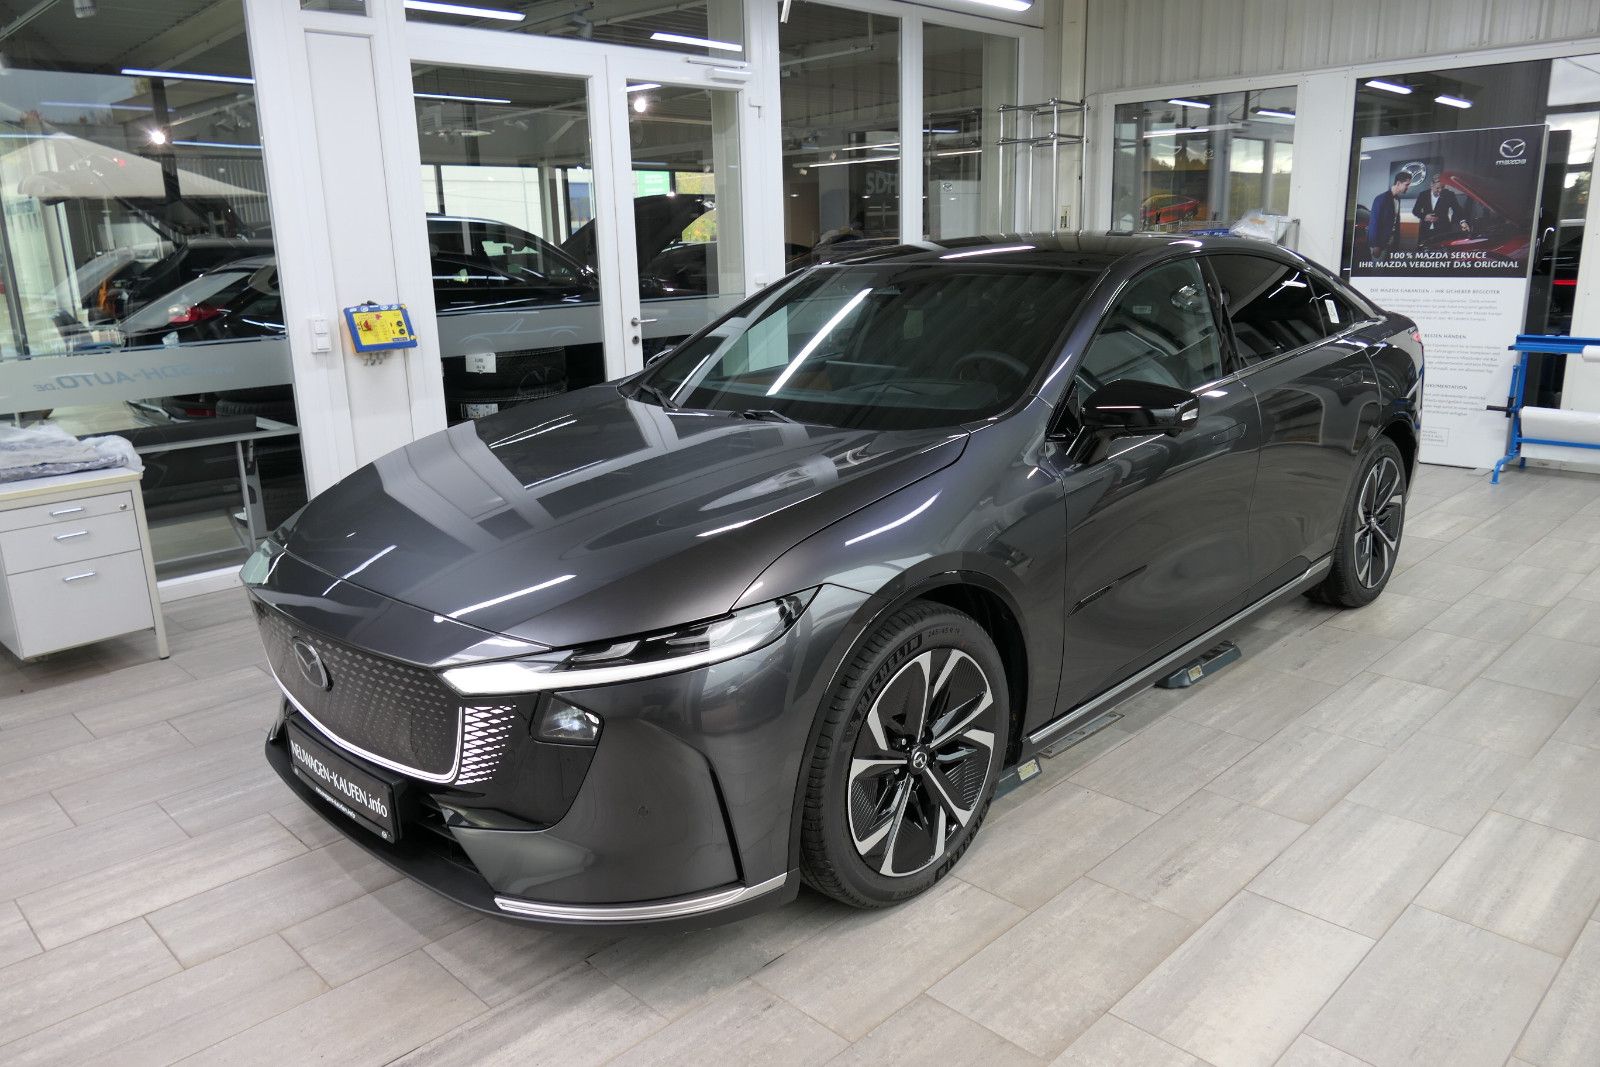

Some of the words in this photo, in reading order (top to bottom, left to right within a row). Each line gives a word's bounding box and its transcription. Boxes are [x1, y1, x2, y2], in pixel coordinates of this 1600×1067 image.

[1496, 158, 1527, 166] mazda
[1450, 251, 1487, 259] SERVICE
[856, 634, 921, 714] MICHELIN
